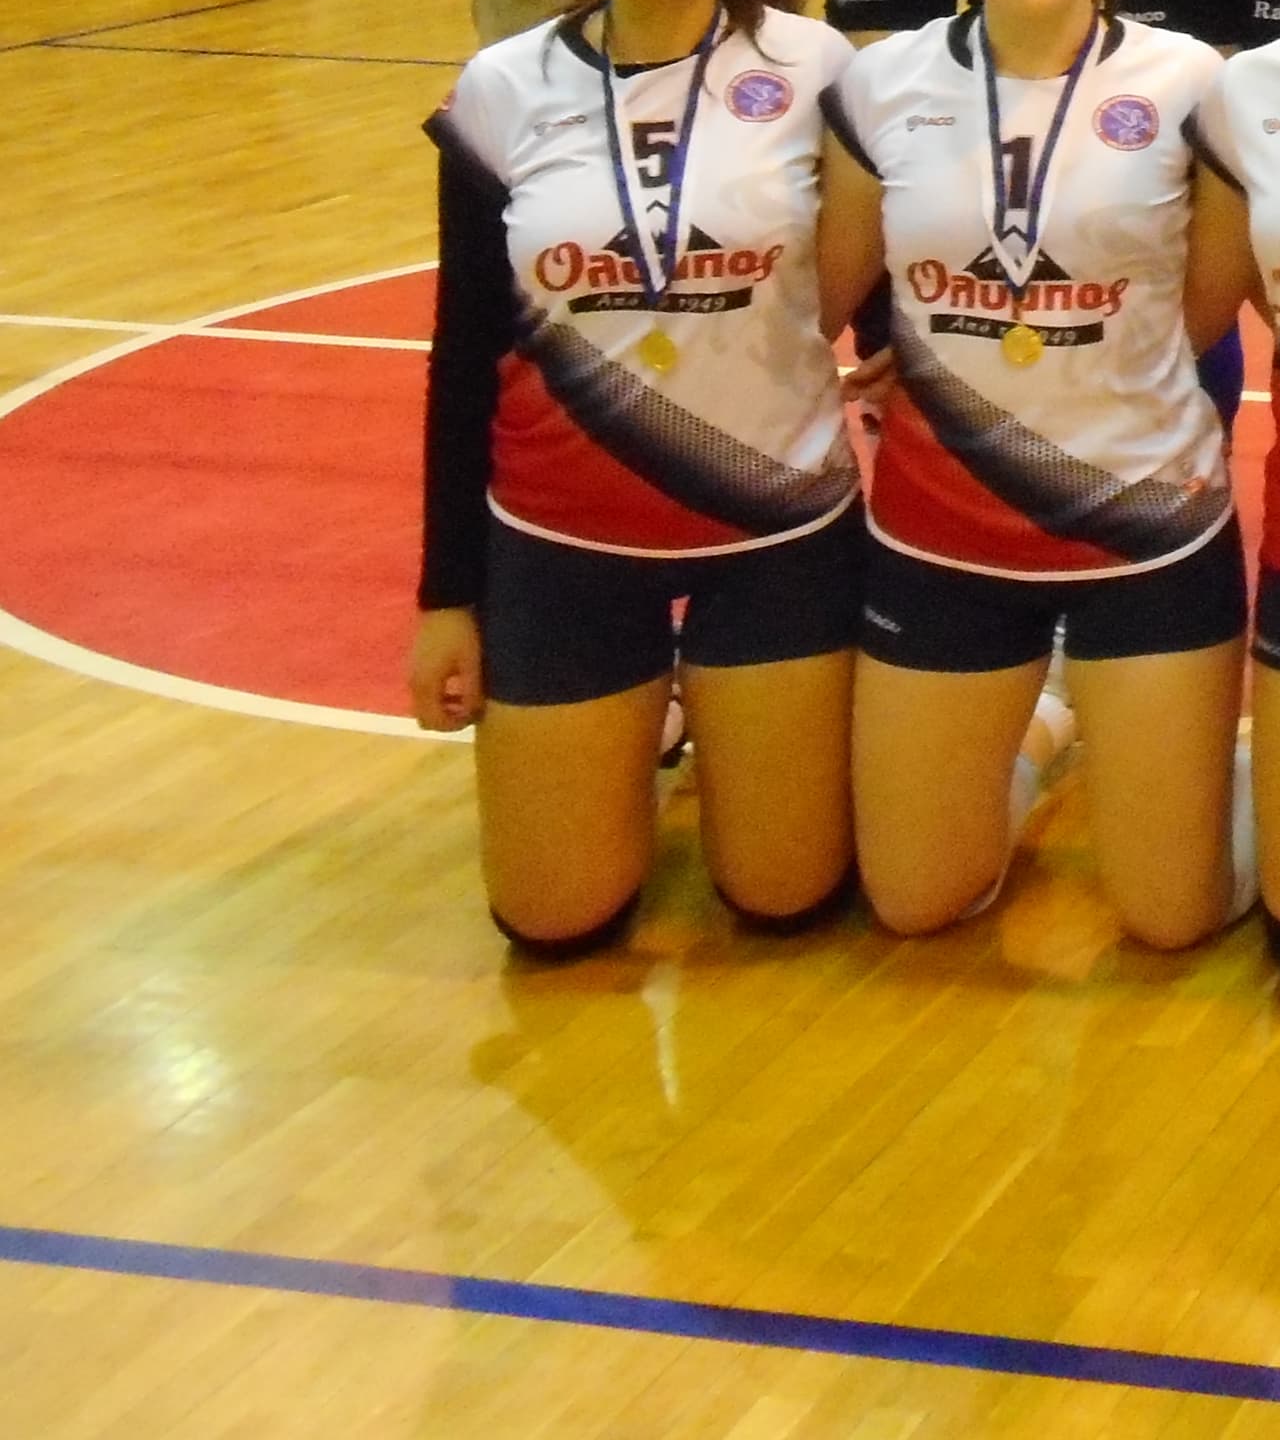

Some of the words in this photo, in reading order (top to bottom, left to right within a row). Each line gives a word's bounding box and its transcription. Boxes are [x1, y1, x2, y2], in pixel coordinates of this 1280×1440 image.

[632, 121, 680, 188] 5
[1000, 135, 1034, 210] 1
[679, 296, 727, 311] 1949
